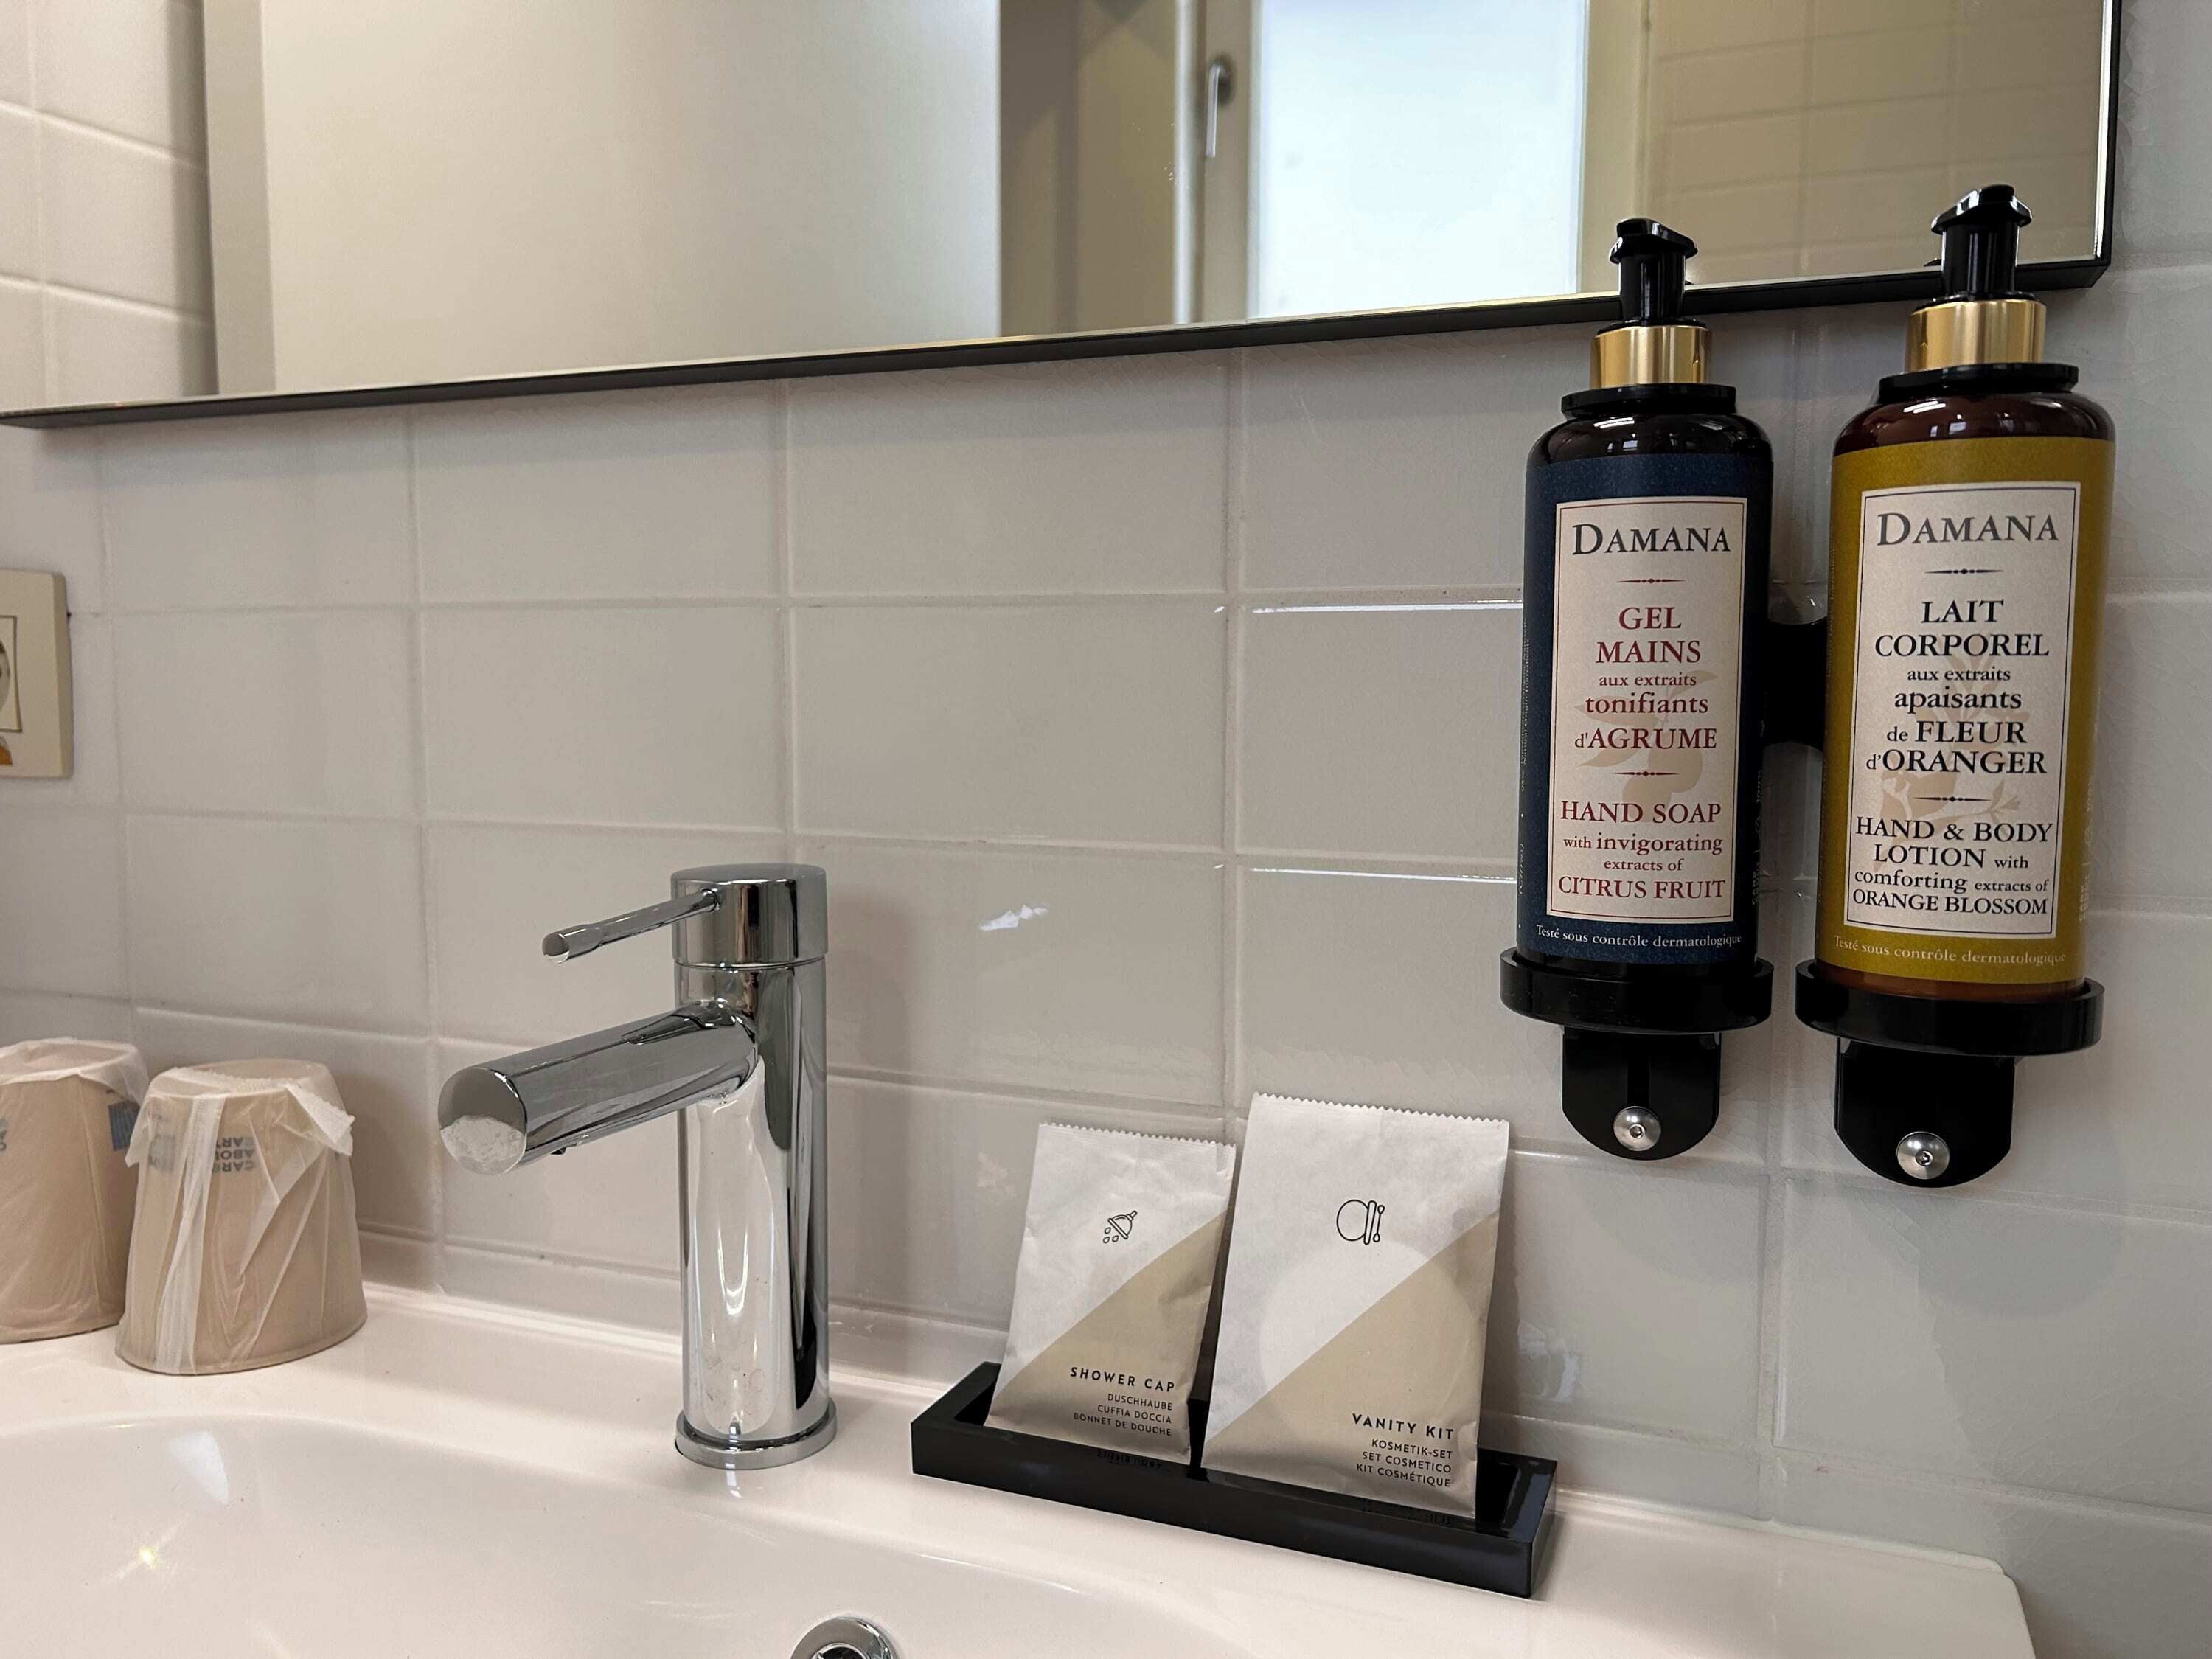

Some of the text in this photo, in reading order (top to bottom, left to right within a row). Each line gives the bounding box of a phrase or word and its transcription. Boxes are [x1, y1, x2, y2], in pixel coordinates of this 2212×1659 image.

[1572, 524, 1731, 555] DAMANA
[1877, 512, 2059, 546] DAMANA
[1618, 607, 1682, 630] GEL
[1921, 599, 2005, 624] LAIT
[1596, 640, 1701, 664] MAINS
[1875, 633, 2050, 657] CORPOREL
[1599, 672, 1697, 686] aux extraits
[1907, 666, 2011, 681] aux extraits
[1586, 692, 1708, 714] tonifiants
[1894, 686, 2023, 714] apaisants
[1887, 720, 2027, 744] de FLEUR
[1560, 801, 1722, 824] HAND SOAP
[1855, 816, 2053, 843] HAND & BODY
[1563, 832, 1723, 855] with invigorating
[1604, 858, 1684, 872] extracts of
[1873, 844, 2029, 869] LOTION with
[1558, 875, 1646, 899] CITRUS
[1654, 879, 1726, 899] FRUIT
[1854, 869, 2050, 894] comforting extracts of
[1852, 888, 2048, 915] ORANGE BLOSSOM
[1536, 924, 1742, 948] Testé sous contrôle dermatologique
[1834, 935, 2067, 966] Testé sous contrôle dermatologique
[1070, 1366, 1175, 1392] SHOWER CAP
[1107, 1393, 1172, 1410] DUSCHHAUBE
[1074, 1412, 1172, 1436] BONNET DE DOUCHE
[1097, 1405, 1172, 1424] CUFFIA DOCCIA
[1352, 1413, 1454, 1440] VANITY KIT
[1371, 1439, 1453, 1459] KOSMETIK-SET
[1362, 1450, 1452, 1474] SET COSMETICO
[1356, 1463, 1451, 1488] KIT COSMÉTIQUE
